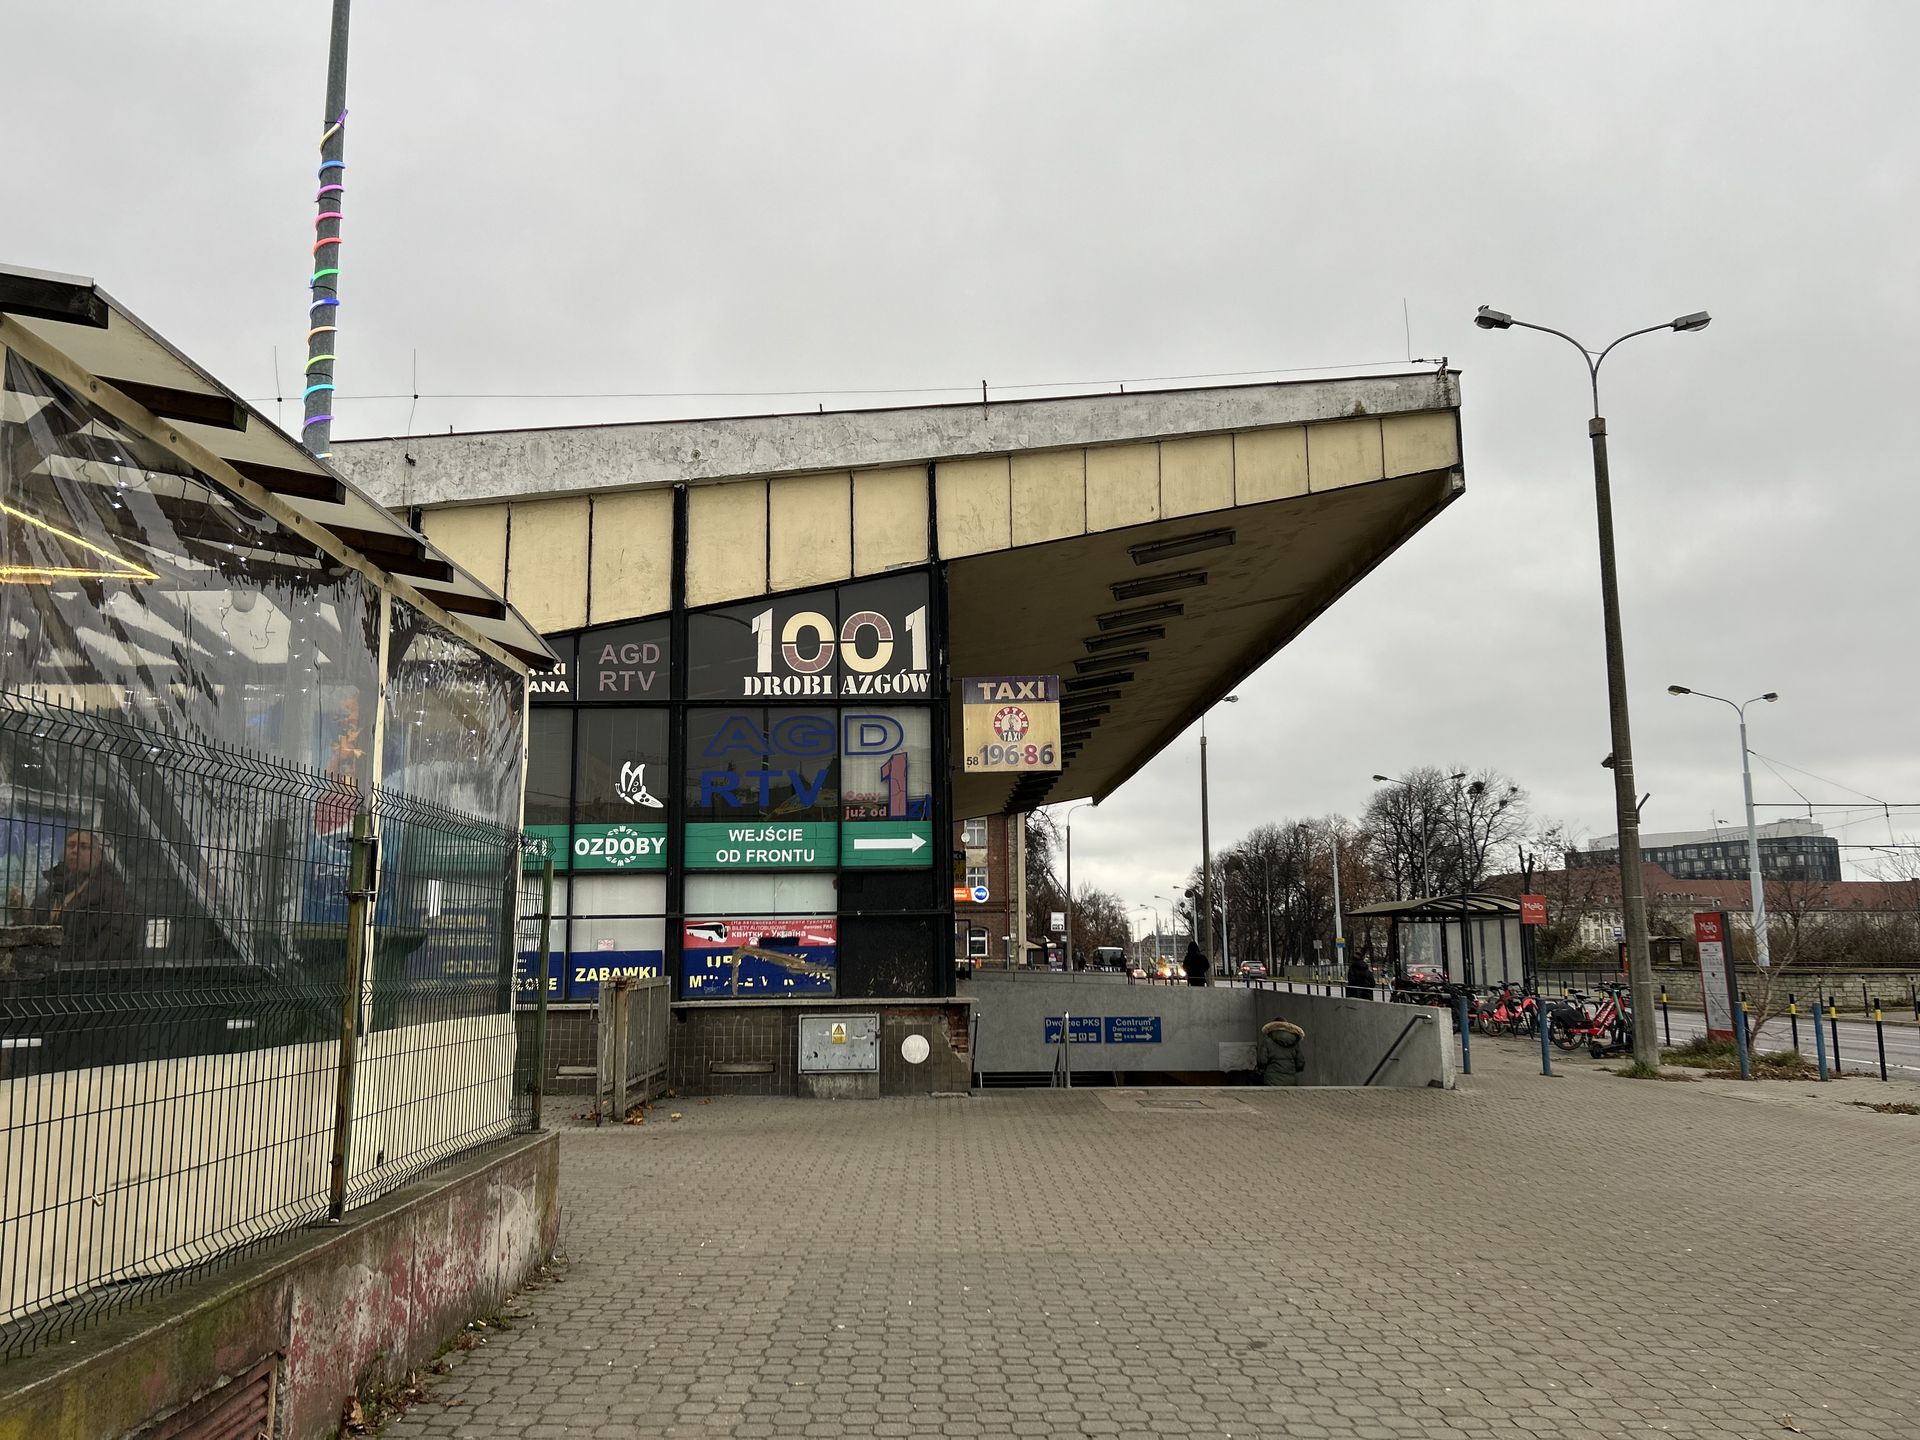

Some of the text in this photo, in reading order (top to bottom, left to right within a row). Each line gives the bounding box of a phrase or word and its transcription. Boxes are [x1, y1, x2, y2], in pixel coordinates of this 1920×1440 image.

[751, 604, 928, 674] 1001
[598, 643, 661, 665] AGD
[599, 670, 657, 692] RTV
[977, 680, 1045, 700] TAXI
[994, 707, 1029, 728] NEPTUN
[703, 714, 904, 756] AGD
[1002, 731, 1021, 742] TAXI
[966, 744, 1054, 766] 58 196-86
[701, 768, 830, 808] RTV
[880, 751, 908, 818] 1
[845, 806, 887, 820] już od
[728, 826, 803, 842] WEJŚCIE
[574, 837, 666, 856] OZDOBY
[715, 849, 815, 863] OD FRONTU
[574, 966, 657, 982] ZABAWKI
[1082, 1018, 1100, 1027] PKS
[1115, 1018, 1151, 1026] Centrum
